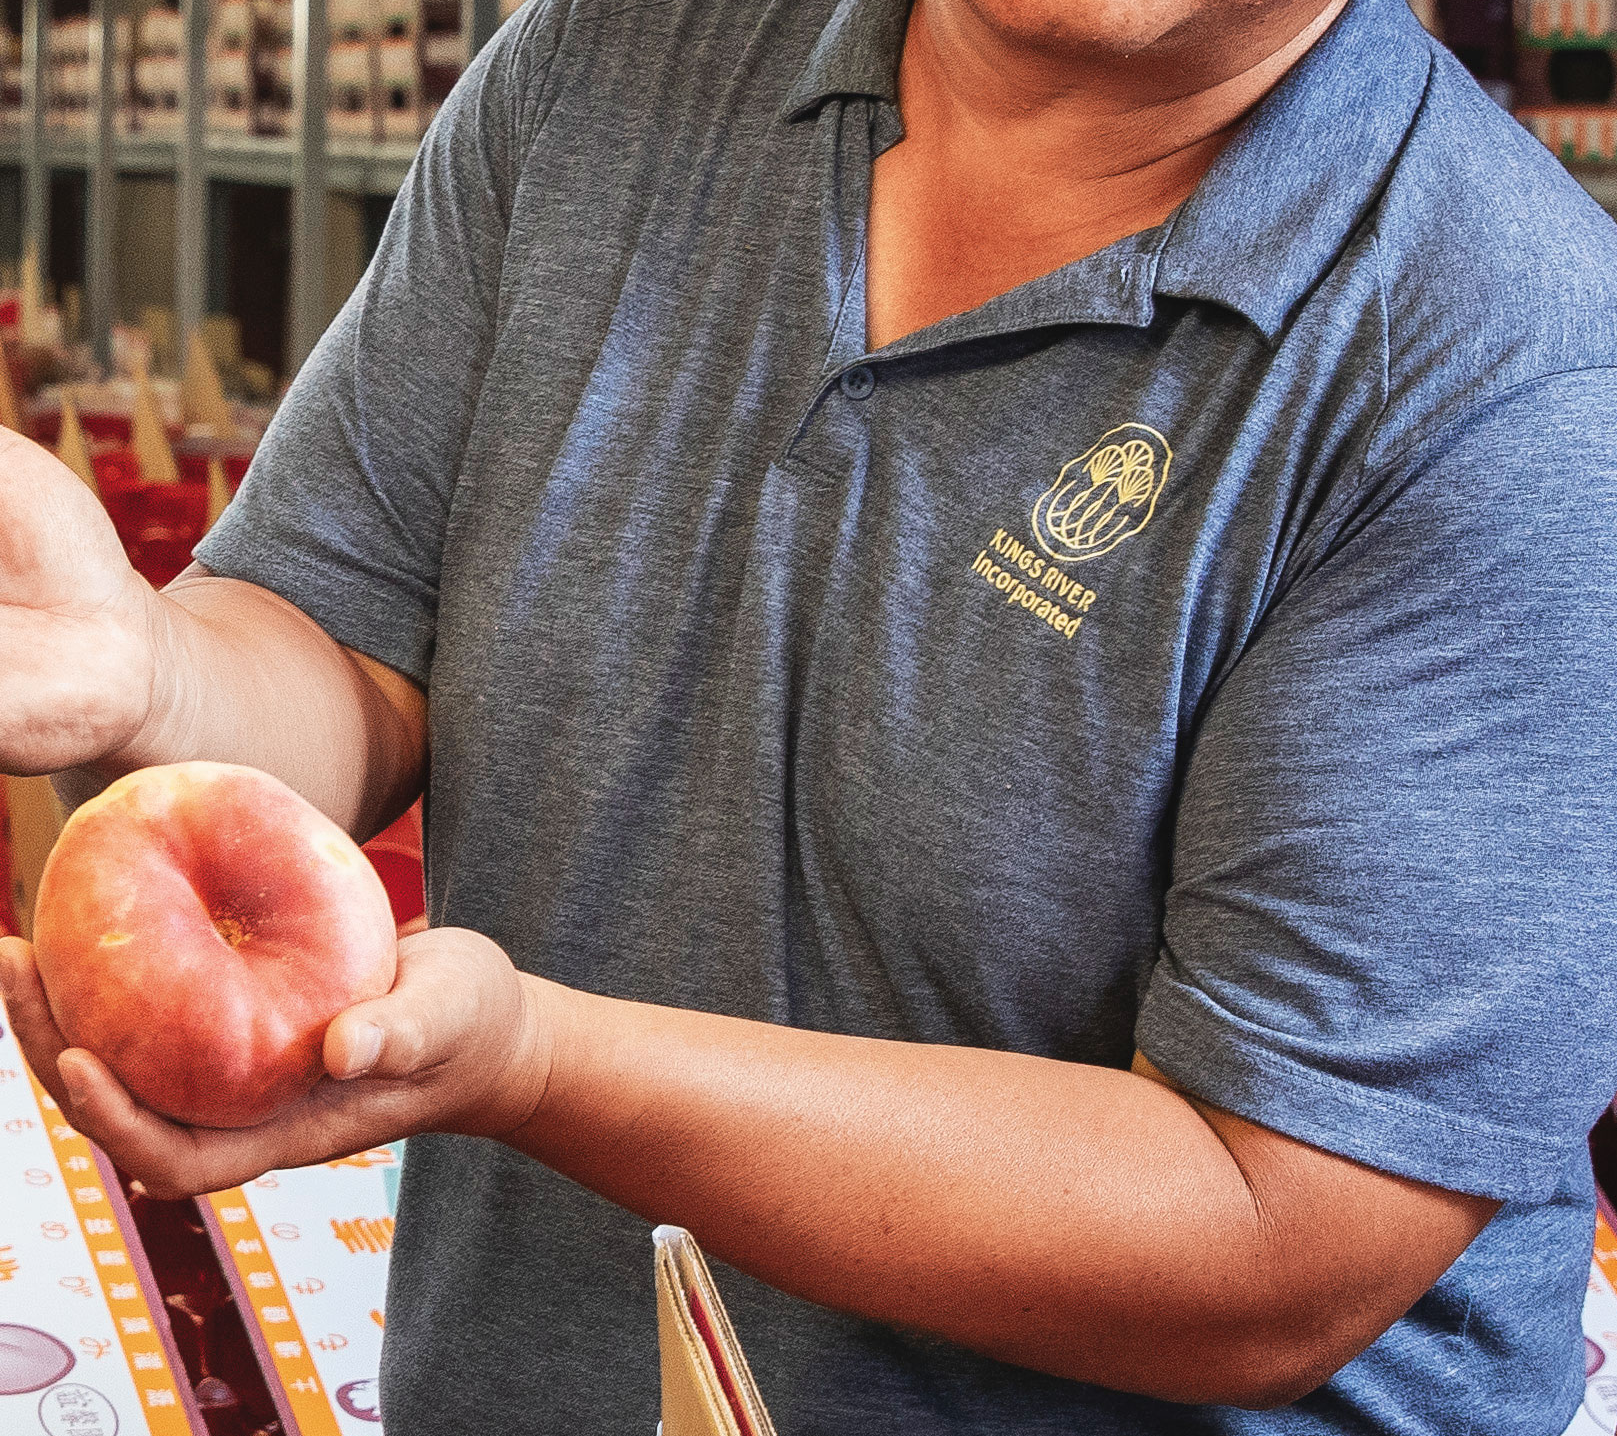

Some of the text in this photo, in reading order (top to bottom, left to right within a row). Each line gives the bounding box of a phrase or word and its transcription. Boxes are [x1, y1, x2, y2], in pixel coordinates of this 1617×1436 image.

[971, 550, 1084, 640] Incorporated
[988, 529, 1097, 613] KINGS RIVER
